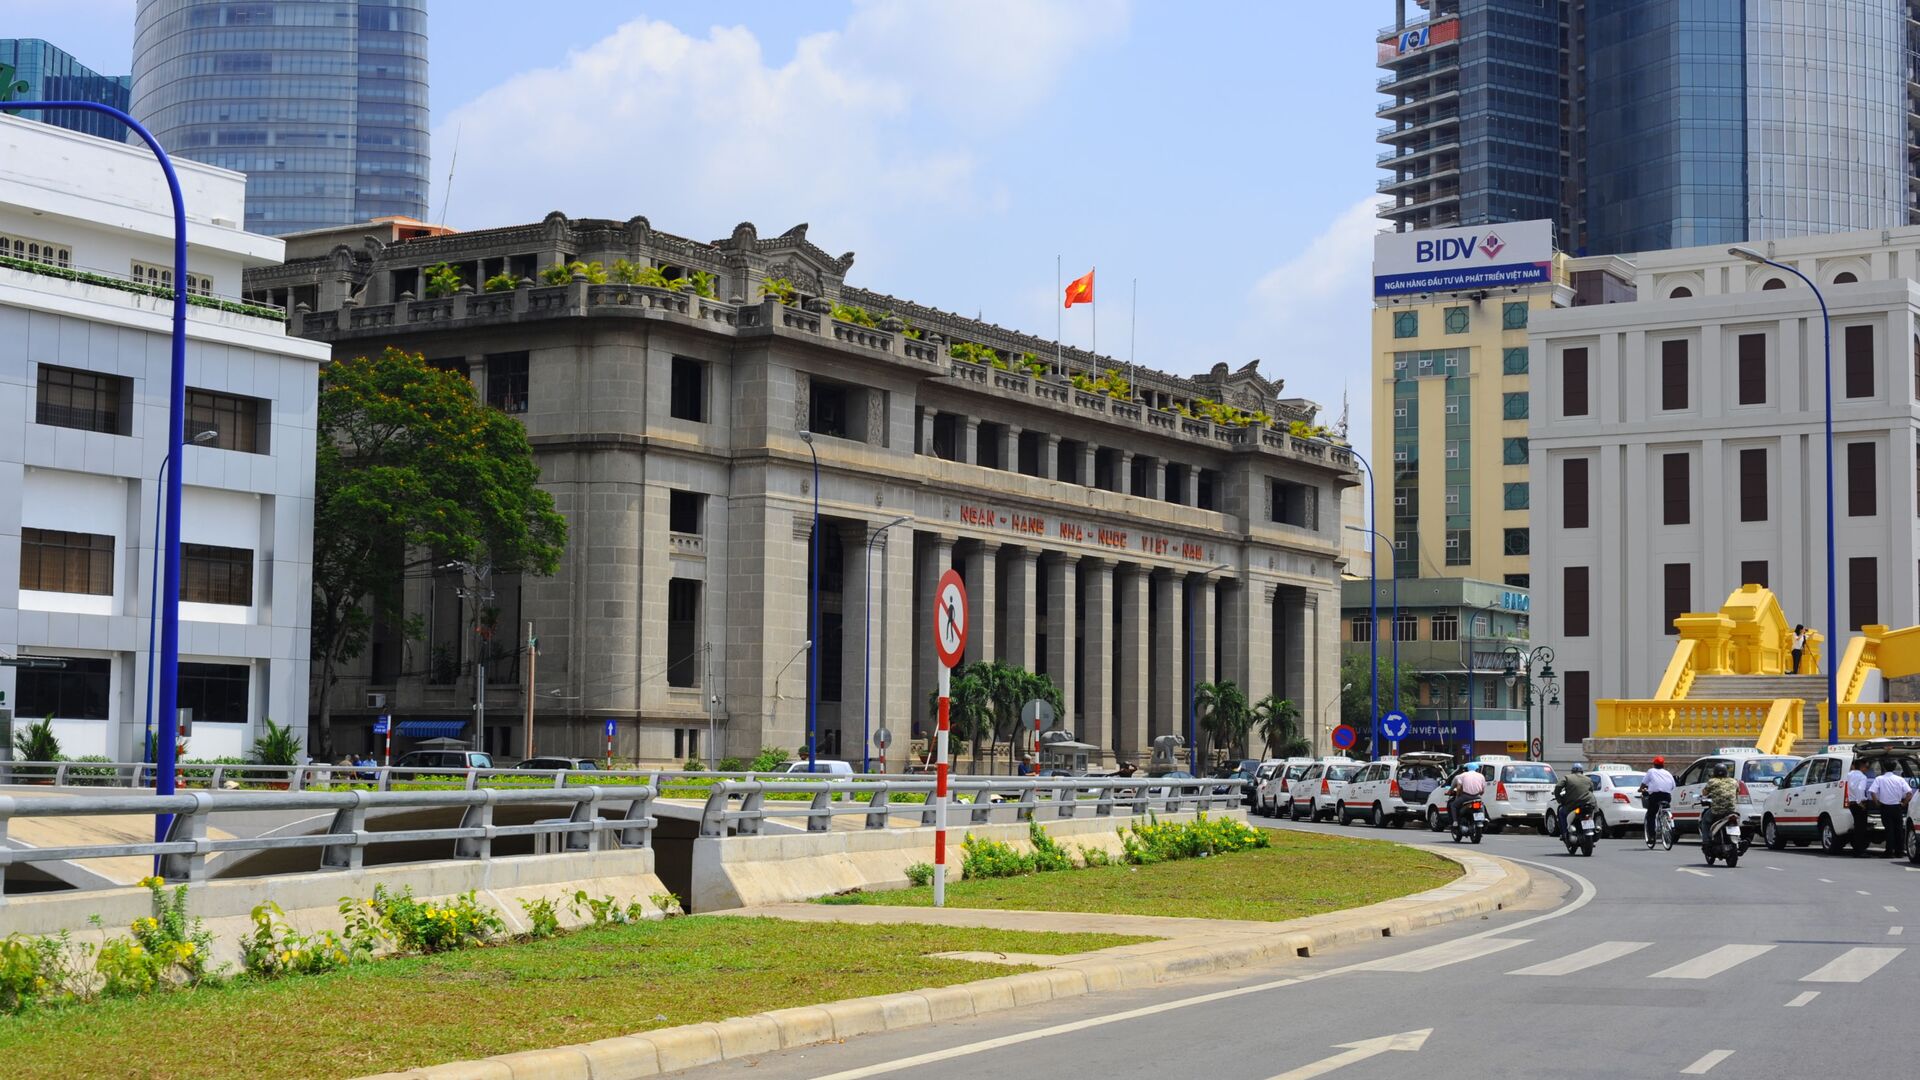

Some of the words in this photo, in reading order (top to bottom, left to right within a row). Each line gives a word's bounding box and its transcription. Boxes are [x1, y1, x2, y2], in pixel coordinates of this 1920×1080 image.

[1416, 236, 1478, 263] BIDV
[1384, 280, 1405, 290] NGÂN
[1406, 278, 1427, 288] HÀNG
[1444, 276, 1454, 284] TƯ
[1454, 275, 1465, 284] VÀ
[1465, 273, 1484, 283] PHÁT
[1506, 270, 1521, 281] VIỆT
[1523, 269, 1540, 278] NAM
[1011, 513, 1044, 534] HANG
[1060, 522, 1083, 540] NHA
[1141, 535, 1169, 555] VIET
[1182, 542, 1203, 560] NAM
[1419, 726, 1436, 736] VIỆT
[1438, 726, 1457, 734] NAM
